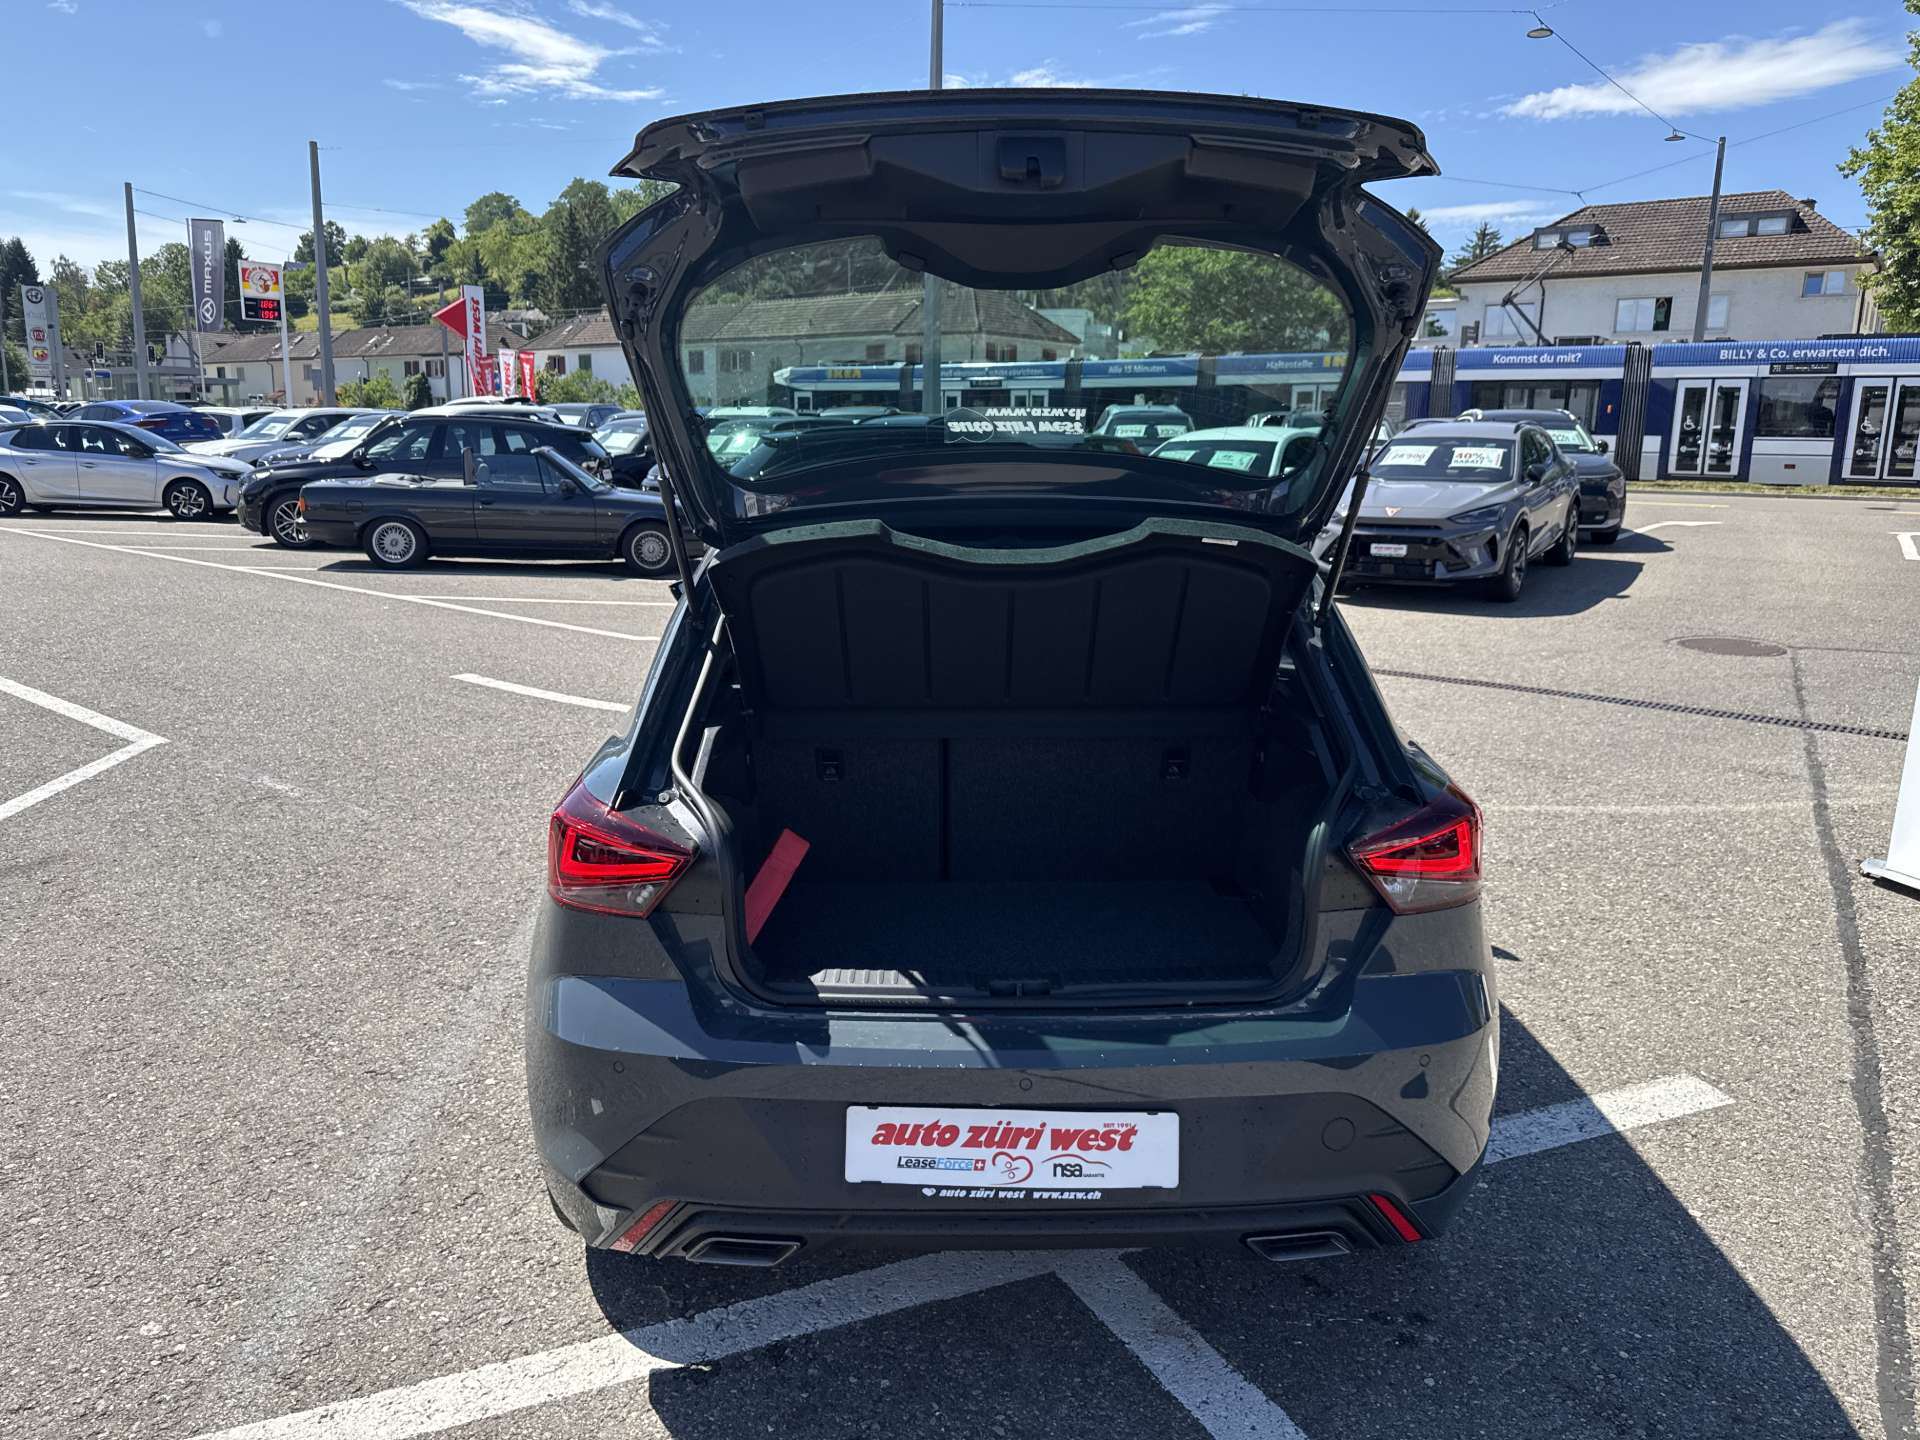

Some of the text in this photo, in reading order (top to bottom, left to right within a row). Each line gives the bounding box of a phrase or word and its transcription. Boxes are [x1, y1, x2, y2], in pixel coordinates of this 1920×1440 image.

[204, 229, 212, 294] MAXUS
[471, 297, 481, 334] west
[1493, 352, 1582, 365] Kommst du mit?
[1719, 346, 1891, 360] BILLY & Co. erwarten dich.
[871, 1118, 1138, 1152] auto züri west
[897, 1156, 973, 1171] LeaseForce
[1053, 1163, 1082, 1178] nsa
[939, 1188, 1102, 1200] auto züri west www.azw.ch
